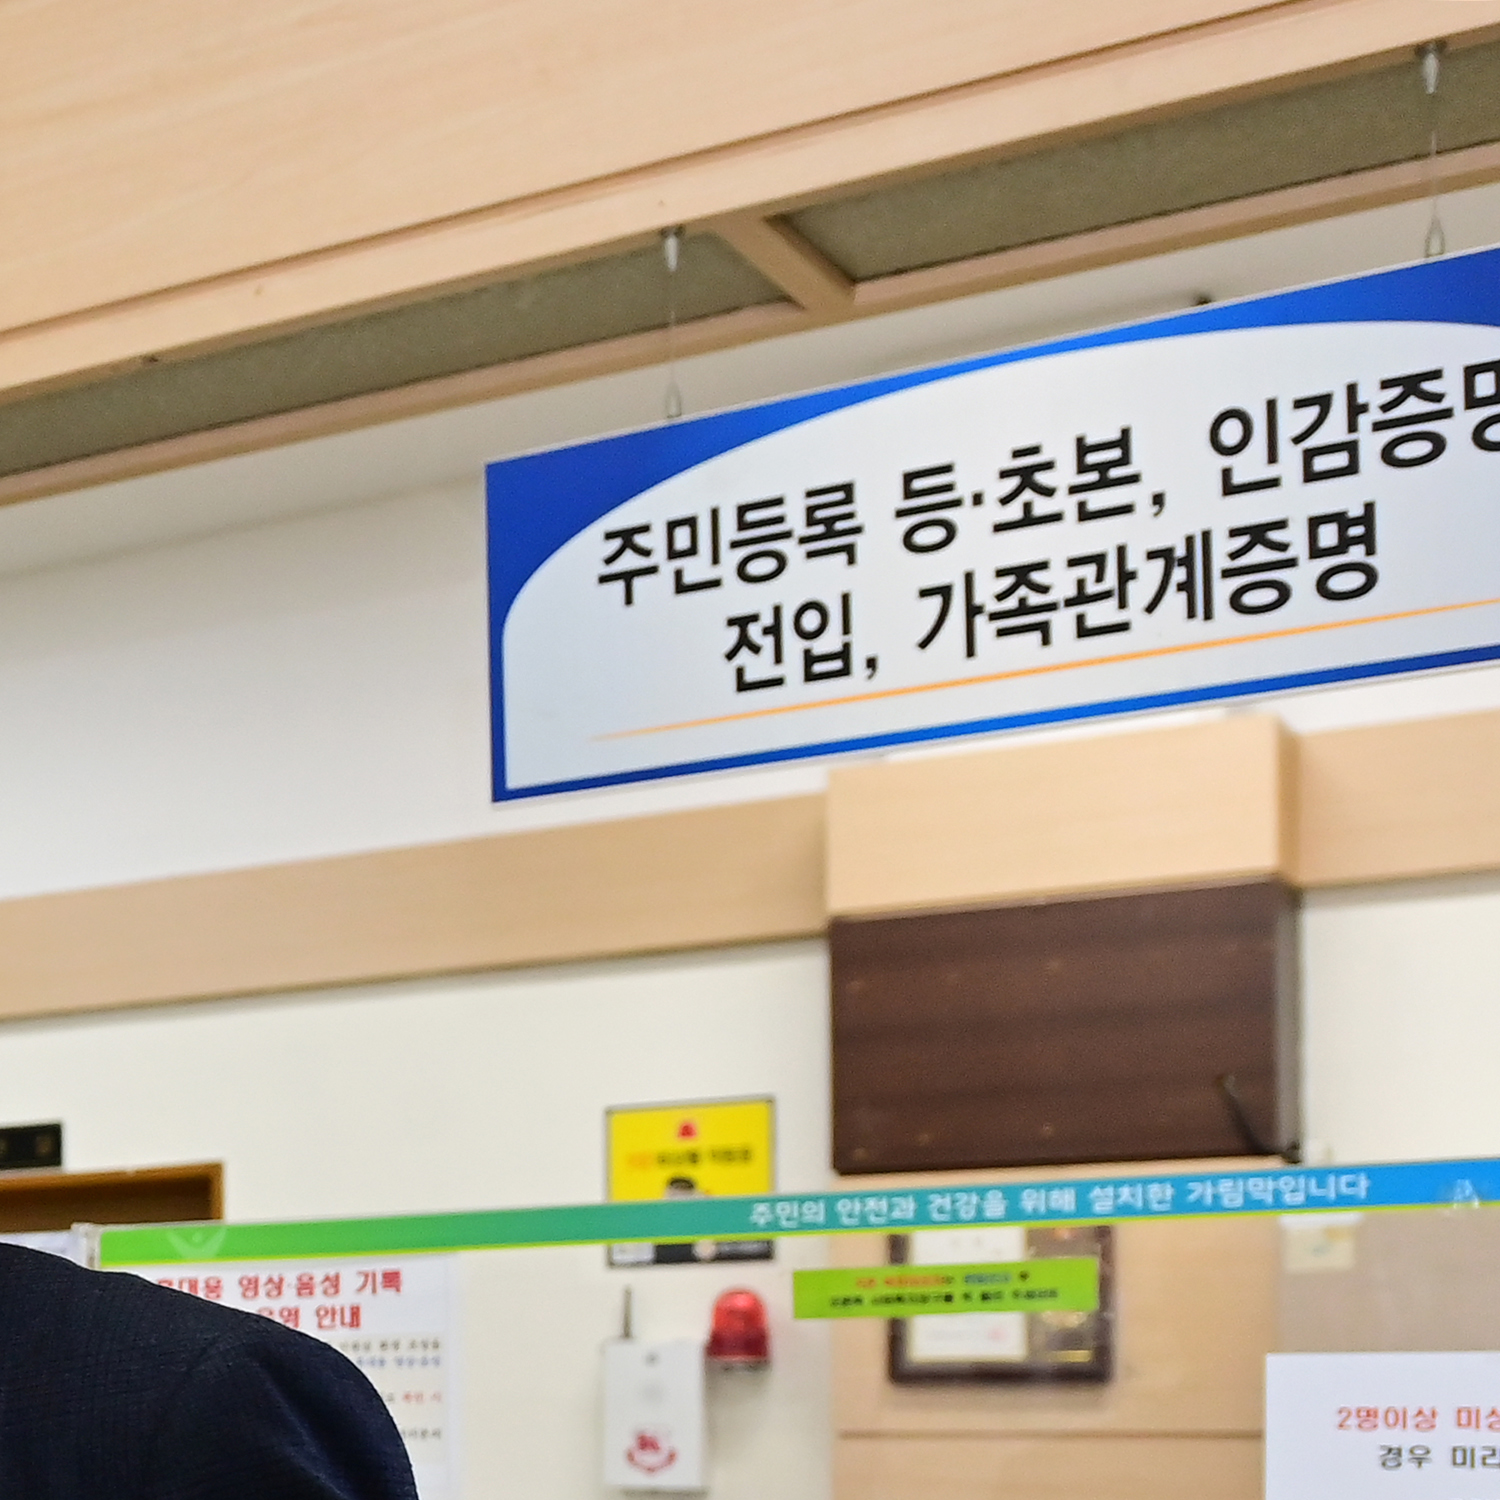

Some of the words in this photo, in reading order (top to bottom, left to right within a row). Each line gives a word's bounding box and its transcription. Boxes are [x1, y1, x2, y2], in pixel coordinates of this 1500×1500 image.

[599, 479, 865, 608] 주민등록
[894, 425, 1166, 558] 등·초본,
[723, 591, 880, 694] 전입,
[915, 501, 1382, 661] 가족관계증명
[751, 1201, 826, 1228] 주민의
[836, 1195, 917, 1226] 안전과
[928, 1189, 1008, 1222] 건강을
[1021, 1189, 1077, 1214] 위해
[1089, 1182, 1175, 1214] 설치한
[1187, 1173, 1371, 1210] 가림막입니다
[356, 1269, 403, 1294] 기록
[315, 1304, 363, 1330] 안내
[1337, 1406, 1438, 1432] 2명이상
[1379, 1445, 1433, 1470] 경우
